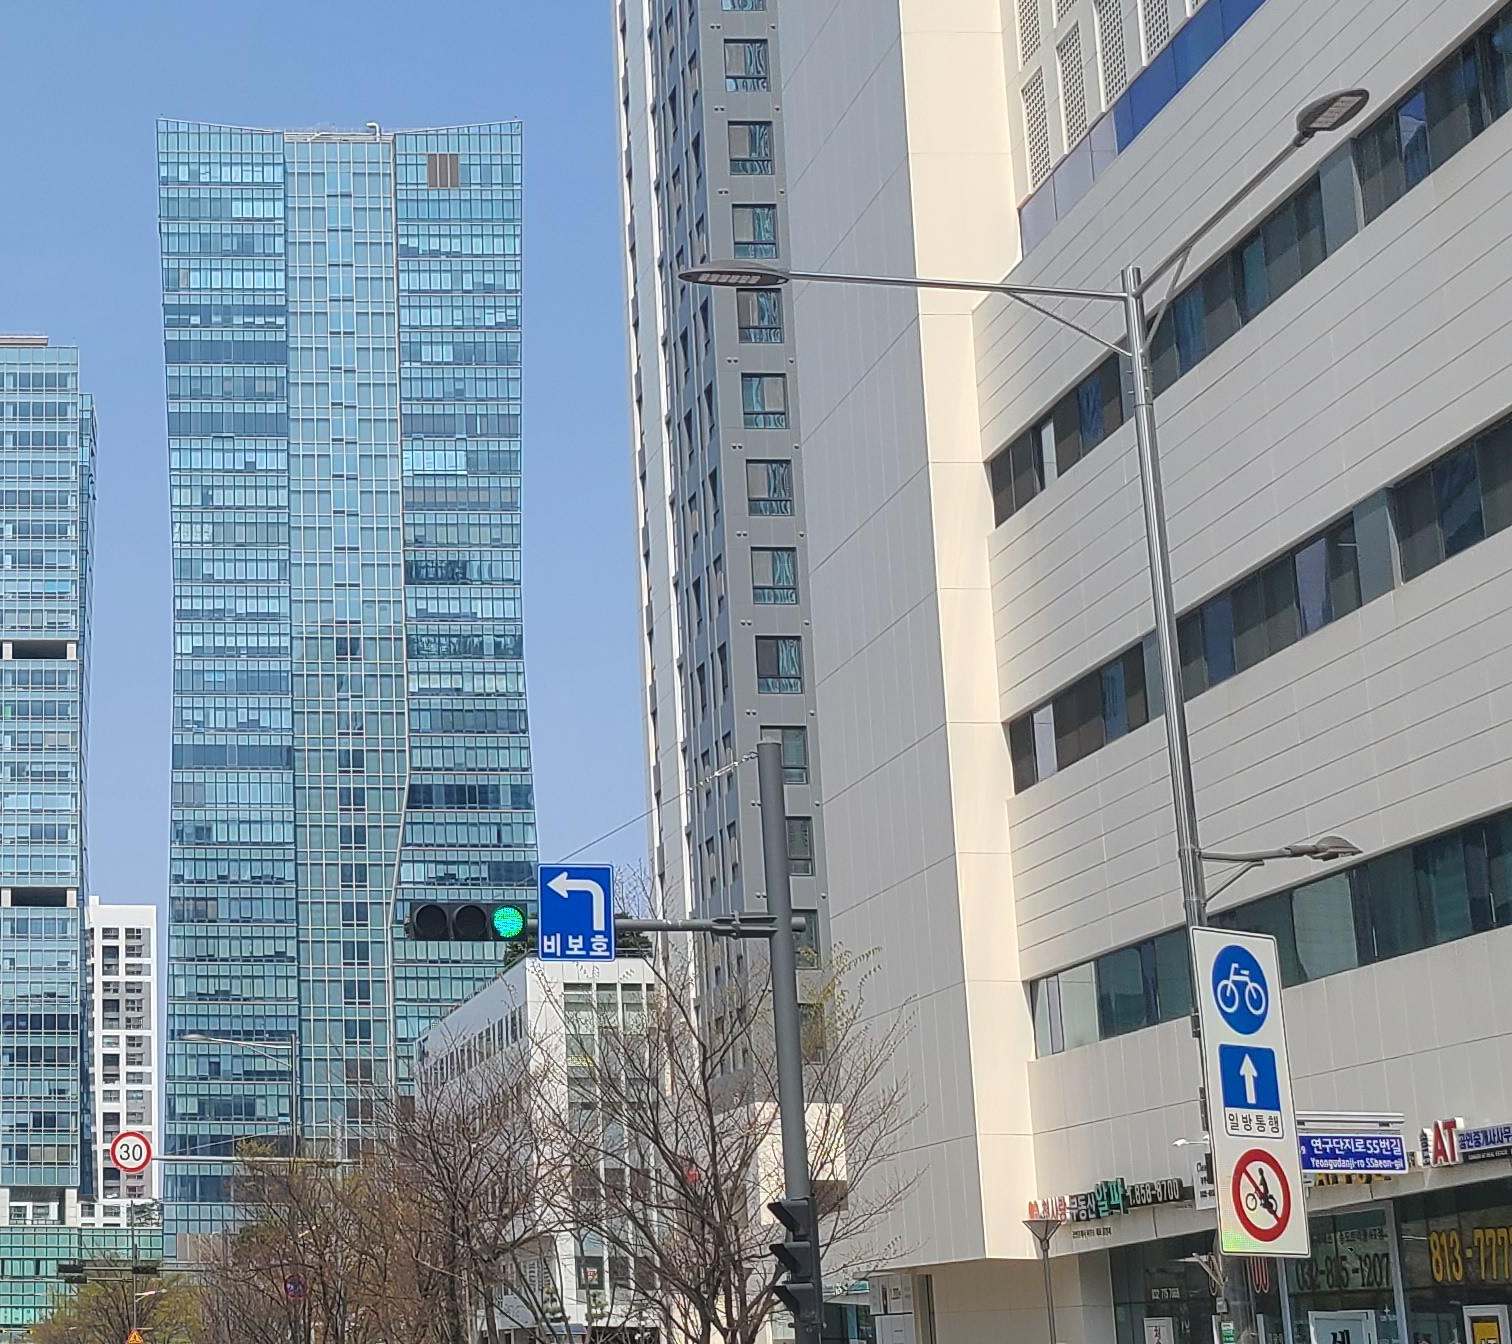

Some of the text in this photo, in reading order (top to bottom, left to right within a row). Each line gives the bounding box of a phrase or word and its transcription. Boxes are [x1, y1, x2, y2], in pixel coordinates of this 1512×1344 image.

[543, 932, 611, 957] 비보호
[1228, 1113, 1280, 1134] 일방통행
[119, 1143, 143, 1162] 30
[1310, 1137, 1402, 1156] 연구단지로55번길
[1432, 1119, 1457, 1165] AT
[1067, 1193, 1096, 1222] 부동산
[1428, 1227, 1512, 1283] 813-777
